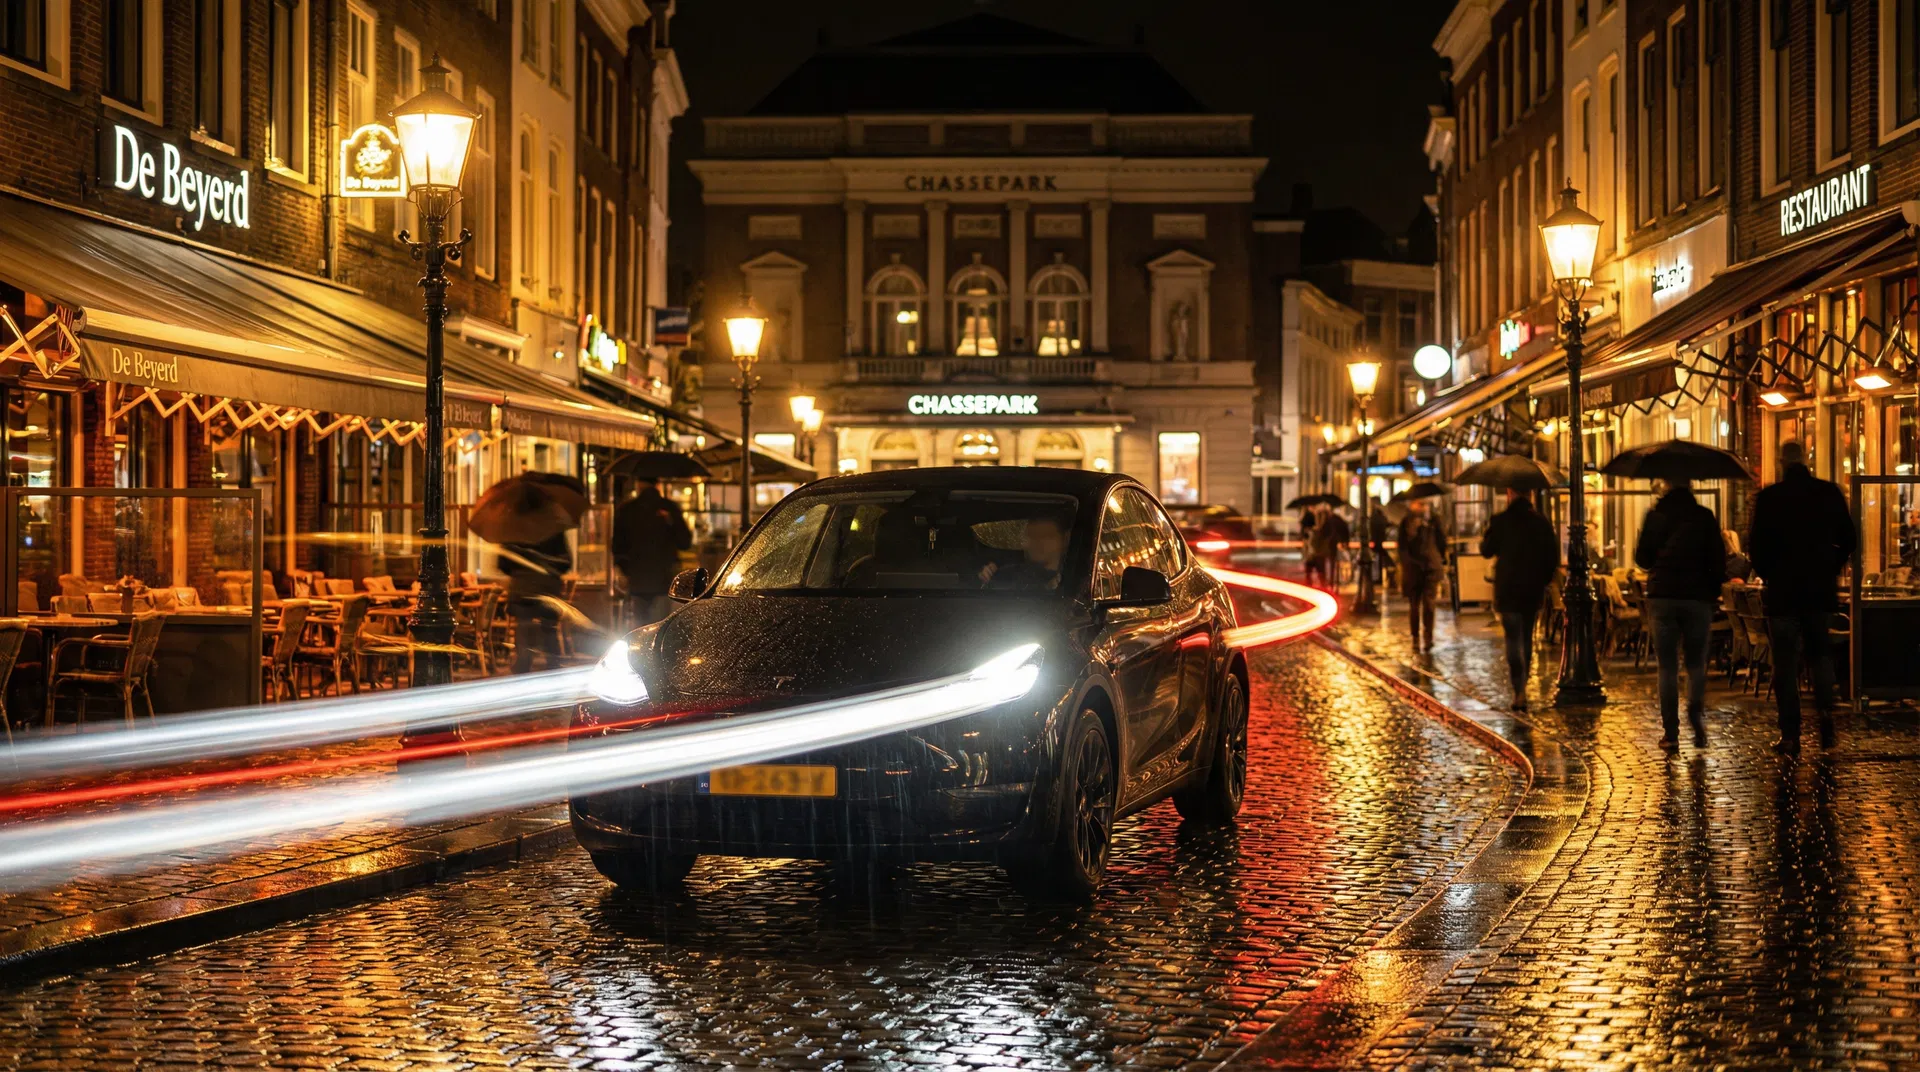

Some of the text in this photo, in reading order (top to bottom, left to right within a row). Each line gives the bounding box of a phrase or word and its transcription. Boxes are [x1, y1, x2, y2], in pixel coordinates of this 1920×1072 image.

[114, 124, 250, 232] De Beyerd
[904, 174, 1058, 192] CHASSEPARK
[1780, 163, 1871, 237] RESTAURANT
[112, 347, 179, 387] De Beyerd
[907, 394, 1039, 415] CHASSEPARK
